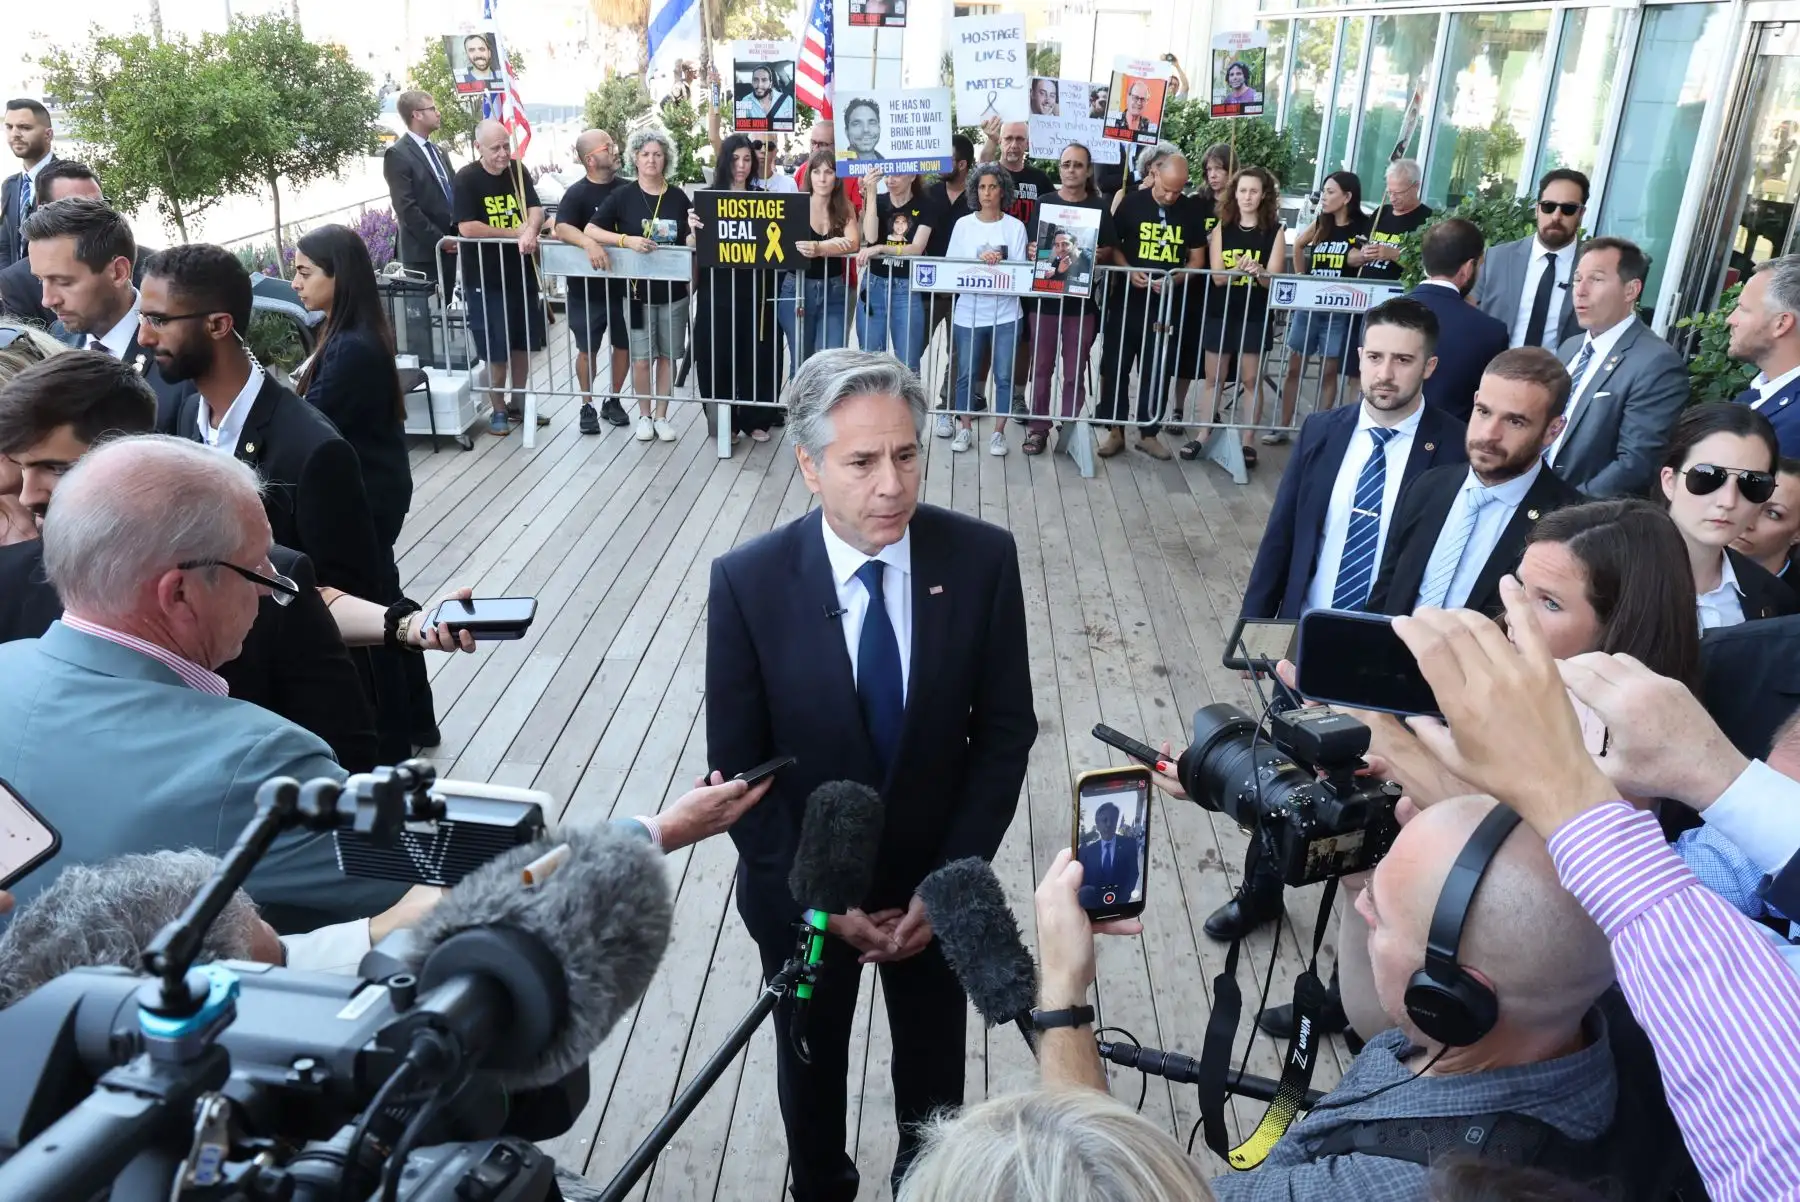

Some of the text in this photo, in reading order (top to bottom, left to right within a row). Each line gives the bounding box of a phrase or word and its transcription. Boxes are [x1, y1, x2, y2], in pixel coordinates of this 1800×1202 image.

[961, 27, 1020, 44] HOSTAGE
[975, 49, 1017, 62] LIVES
[966, 77, 1024, 91] MATTER
[889, 99, 930, 110] HE HAS NO
[890, 112, 943, 124] TIME TO WAIT.
[890, 126, 931, 137] BRING HIM
[891, 138, 940, 151] HOME ALIVE!
[848, 163, 872, 175] BRING
[896, 161, 918, 173] HOME
[920, 160, 941, 171] NOW!
[484, 194, 518, 214] SEA
[717, 198, 785, 219] HOSTAGE
[488, 213, 521, 229] DEA
[718, 220, 757, 240] DEAL
[1139, 221, 1184, 245] SEAL
[719, 242, 757, 264] NOW
[1138, 240, 1180, 263] DEAL
[1330, 241, 1349, 254] למה
[1312, 254, 1345, 269] עדיין
[1314, 294, 1350, 307] נתנוב
[1291, 1014, 1312, 1070] Nikon Z
